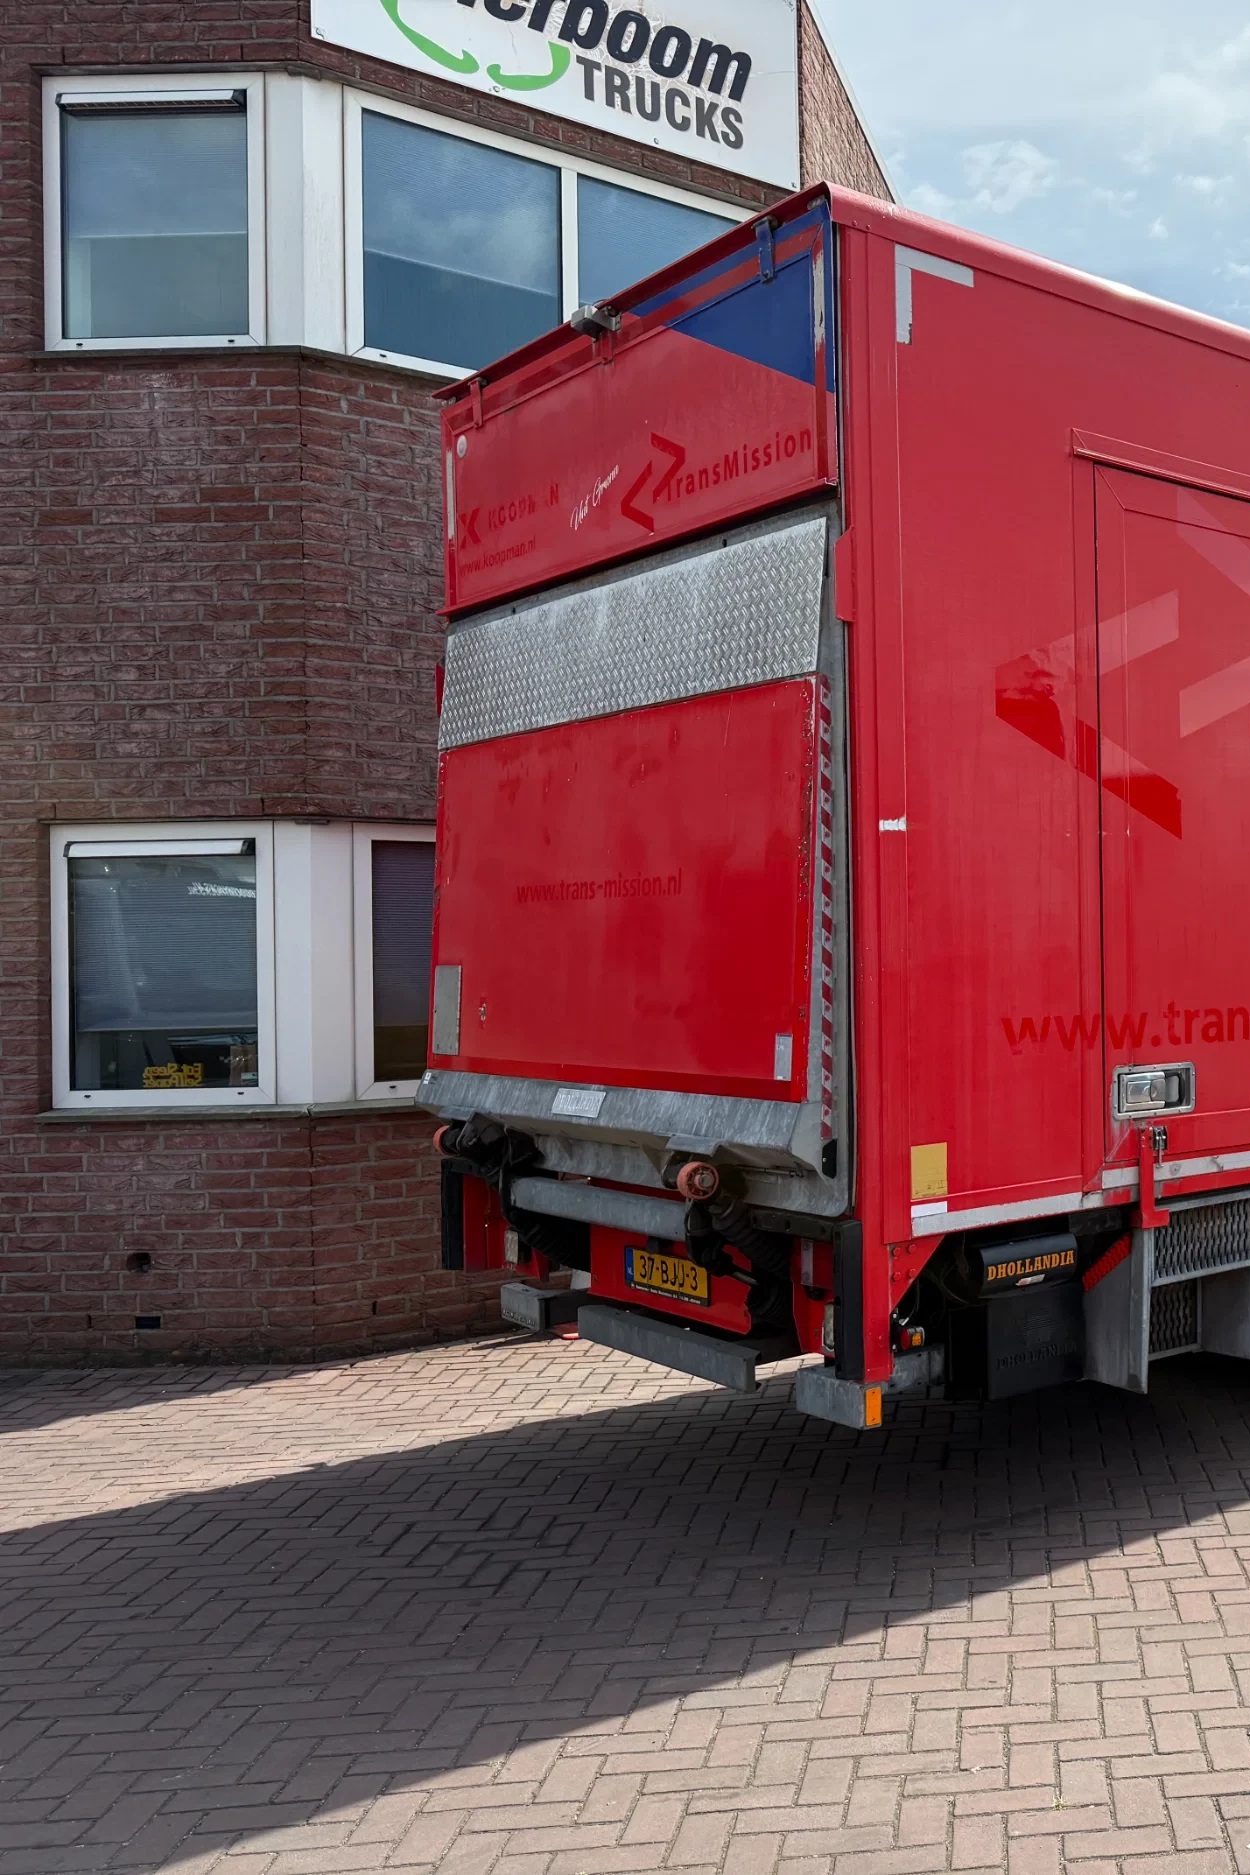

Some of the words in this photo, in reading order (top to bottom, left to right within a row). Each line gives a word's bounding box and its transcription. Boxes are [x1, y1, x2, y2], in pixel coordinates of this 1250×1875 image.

[457, 0, 752, 103] rboom
[575, 54, 744, 149] TRUCKS
[663, 427, 812, 502] TransMission
[516, 867, 683, 904] www.trans-mission.nl
[639, 1255, 698, 1291] 37-BJJ-3
[987, 1250, 1075, 1281] DHOLLANDIA
